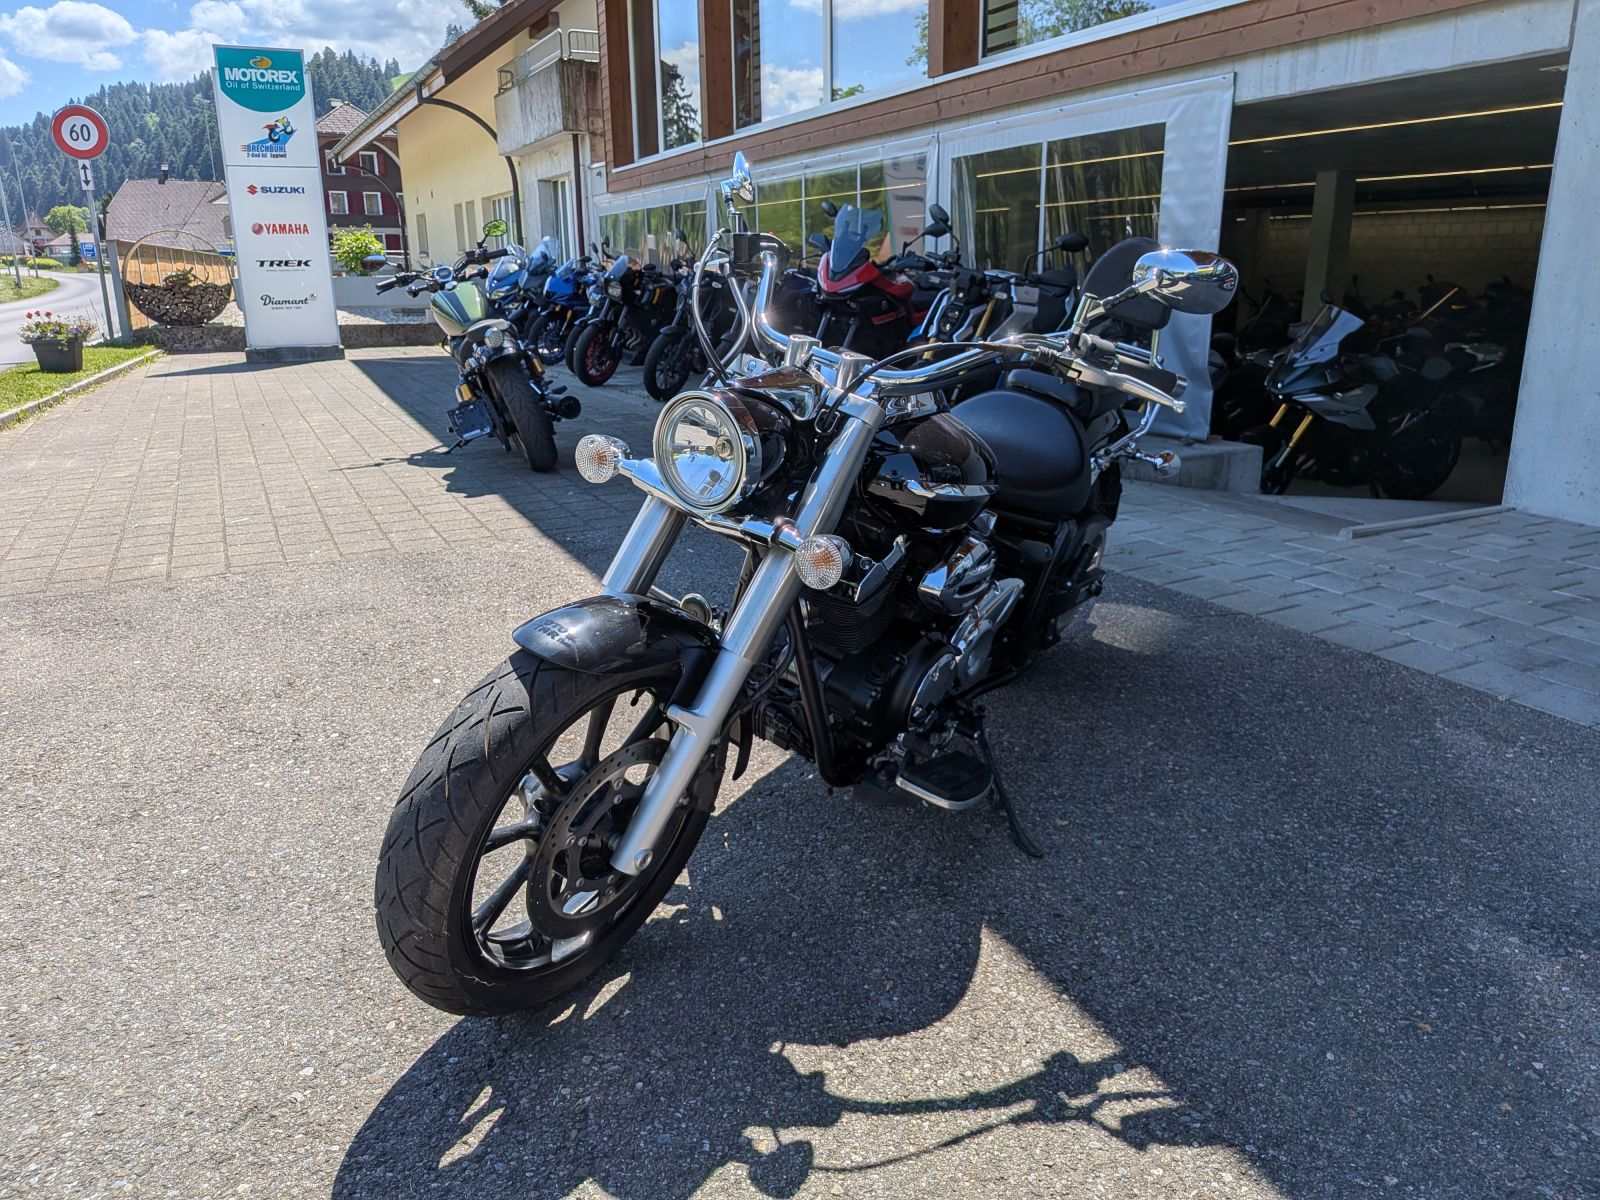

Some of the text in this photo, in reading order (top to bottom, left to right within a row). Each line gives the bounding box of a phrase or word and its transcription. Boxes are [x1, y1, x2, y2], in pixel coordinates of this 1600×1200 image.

[224, 67, 299, 83] MOTOREX
[241, 81, 249, 89] of
[252, 82, 300, 91] Switzerland
[70, 124, 91, 142] 60
[260, 186, 305, 194] SUZUKI
[264, 223, 309, 235] YAMAHA
[256, 259, 312, 267] TREK
[260, 294, 309, 306] Diamant
